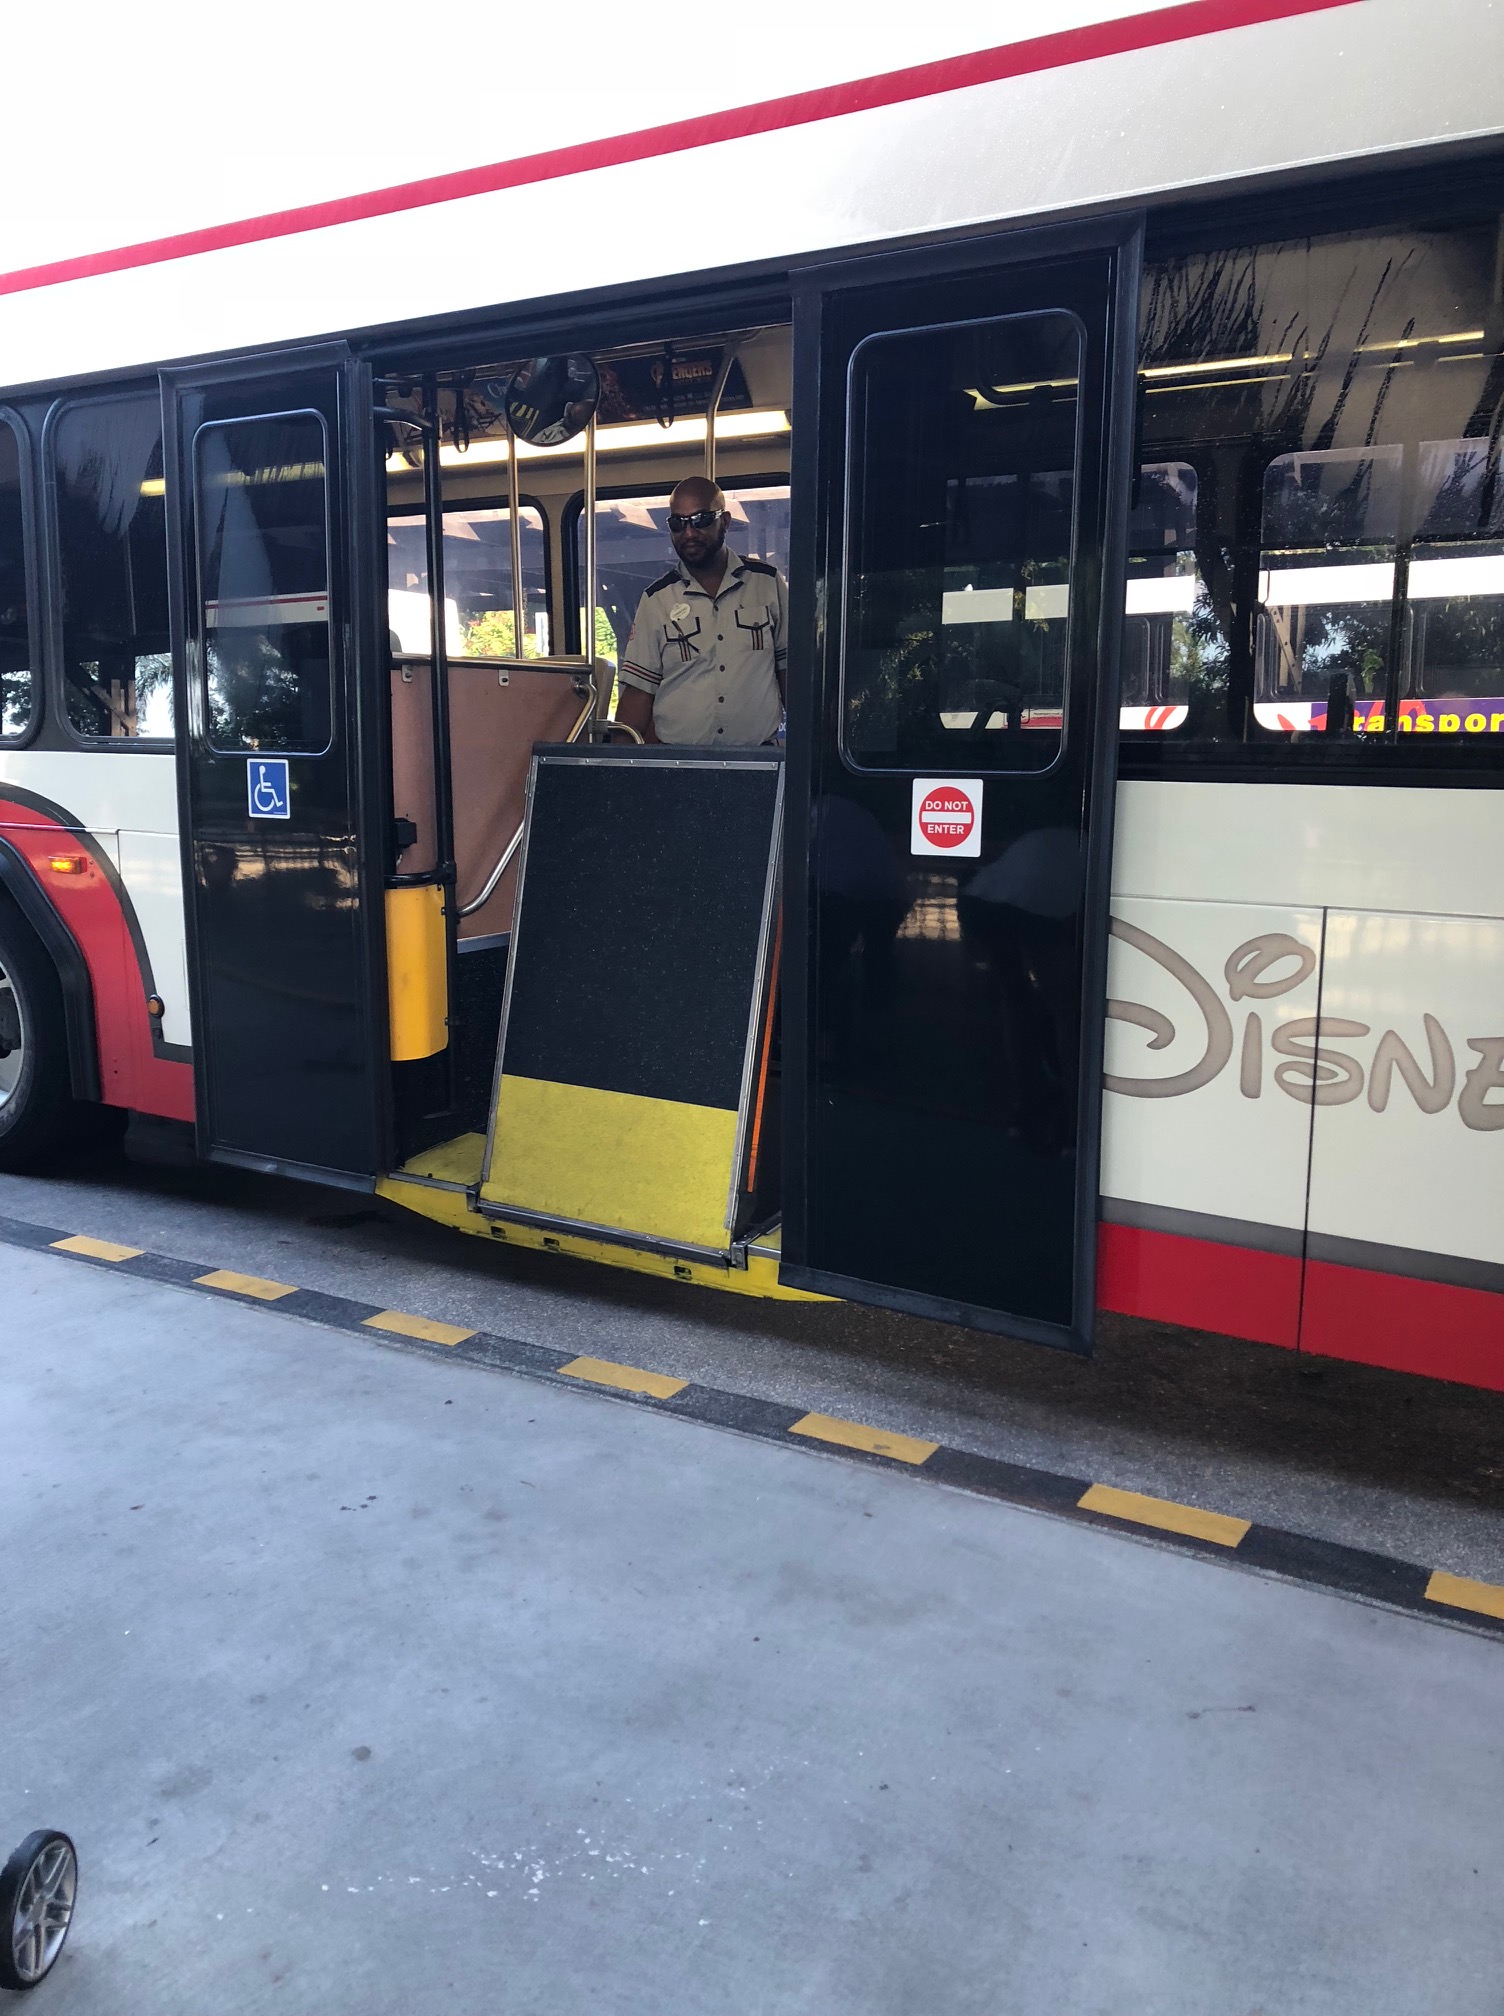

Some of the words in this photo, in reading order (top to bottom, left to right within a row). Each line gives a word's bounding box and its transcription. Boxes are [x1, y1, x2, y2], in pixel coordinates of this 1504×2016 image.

[1353, 713, 1504, 732] ranspor
[925, 801, 942, 810] DO
[944, 801, 968, 810] NOT
[927, 824, 964, 834] ENTER
